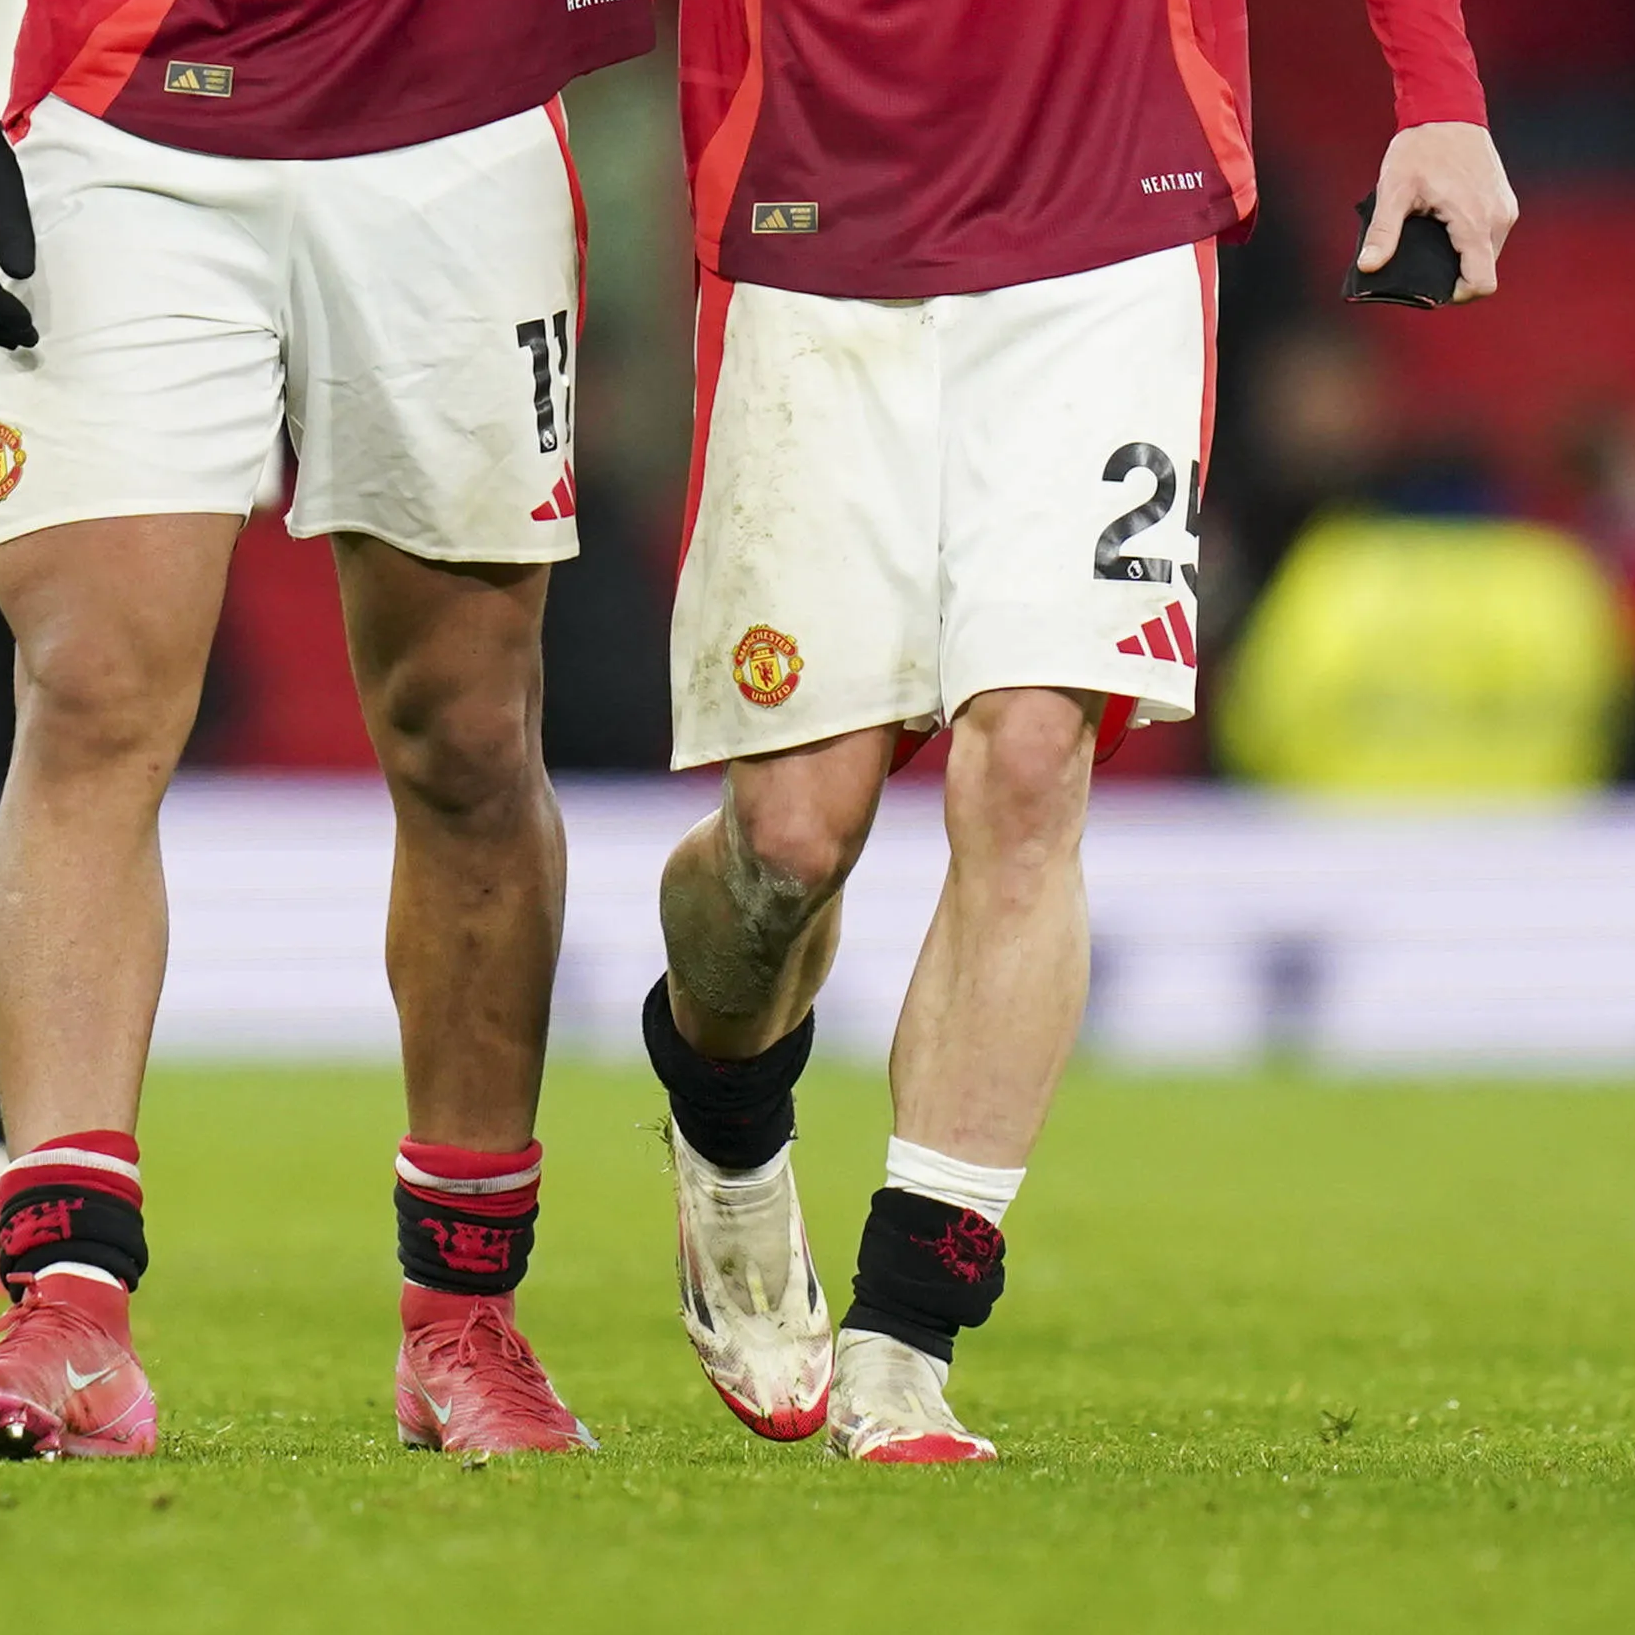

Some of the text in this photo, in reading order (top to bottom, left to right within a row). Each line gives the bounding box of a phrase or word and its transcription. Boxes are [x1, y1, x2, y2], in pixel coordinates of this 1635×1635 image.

[1140, 171, 1203, 194] HEAT.RDY
[737, 631, 792, 660] MANCHESTER
[751, 684, 791, 702] UNITED
